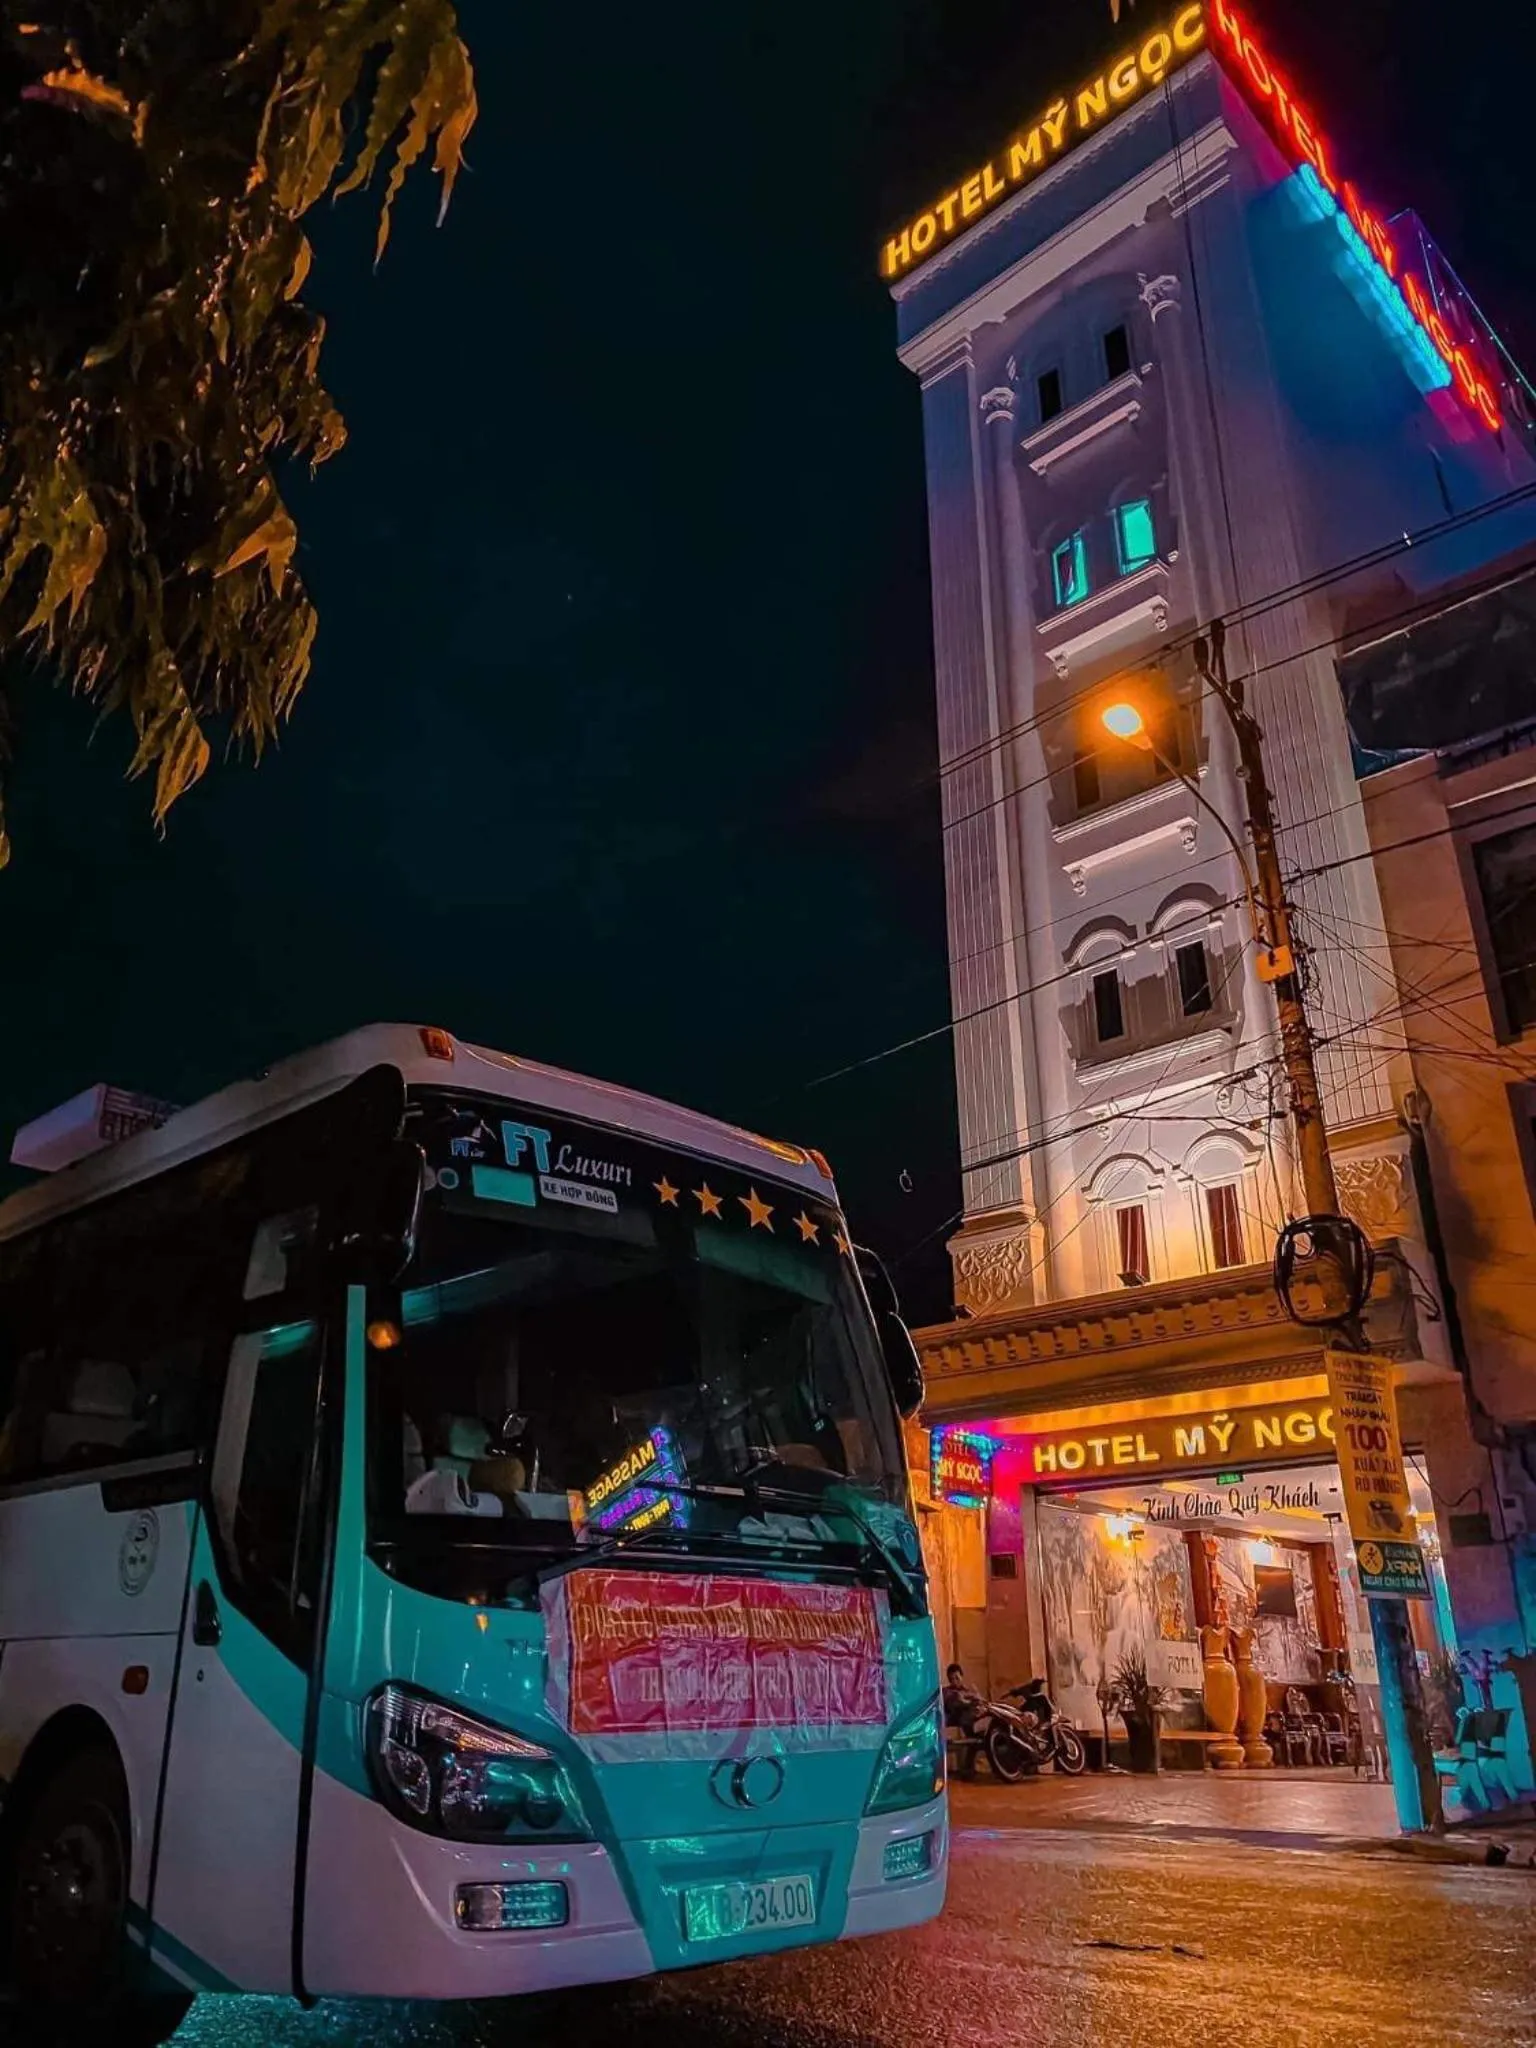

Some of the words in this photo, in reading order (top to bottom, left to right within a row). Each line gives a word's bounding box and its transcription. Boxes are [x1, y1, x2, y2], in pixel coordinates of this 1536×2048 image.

[1214, 0, 1338, 194] HOTEL
[884, 163, 1006, 277] HOTEL
[1009, 99, 1067, 181] MỸ
[1076, 3, 1205, 129] NGỌC
[501, 1120, 552, 1173] FT
[543, 1181, 557, 1195] XE
[1033, 1433, 1160, 1473] HOTEL
[1174, 1413, 1237, 1458] MỸ
[1184, 1491, 1222, 1519] Chào
[1228, 1486, 1260, 1518] Quý
[1264, 1481, 1321, 1511] Khách
